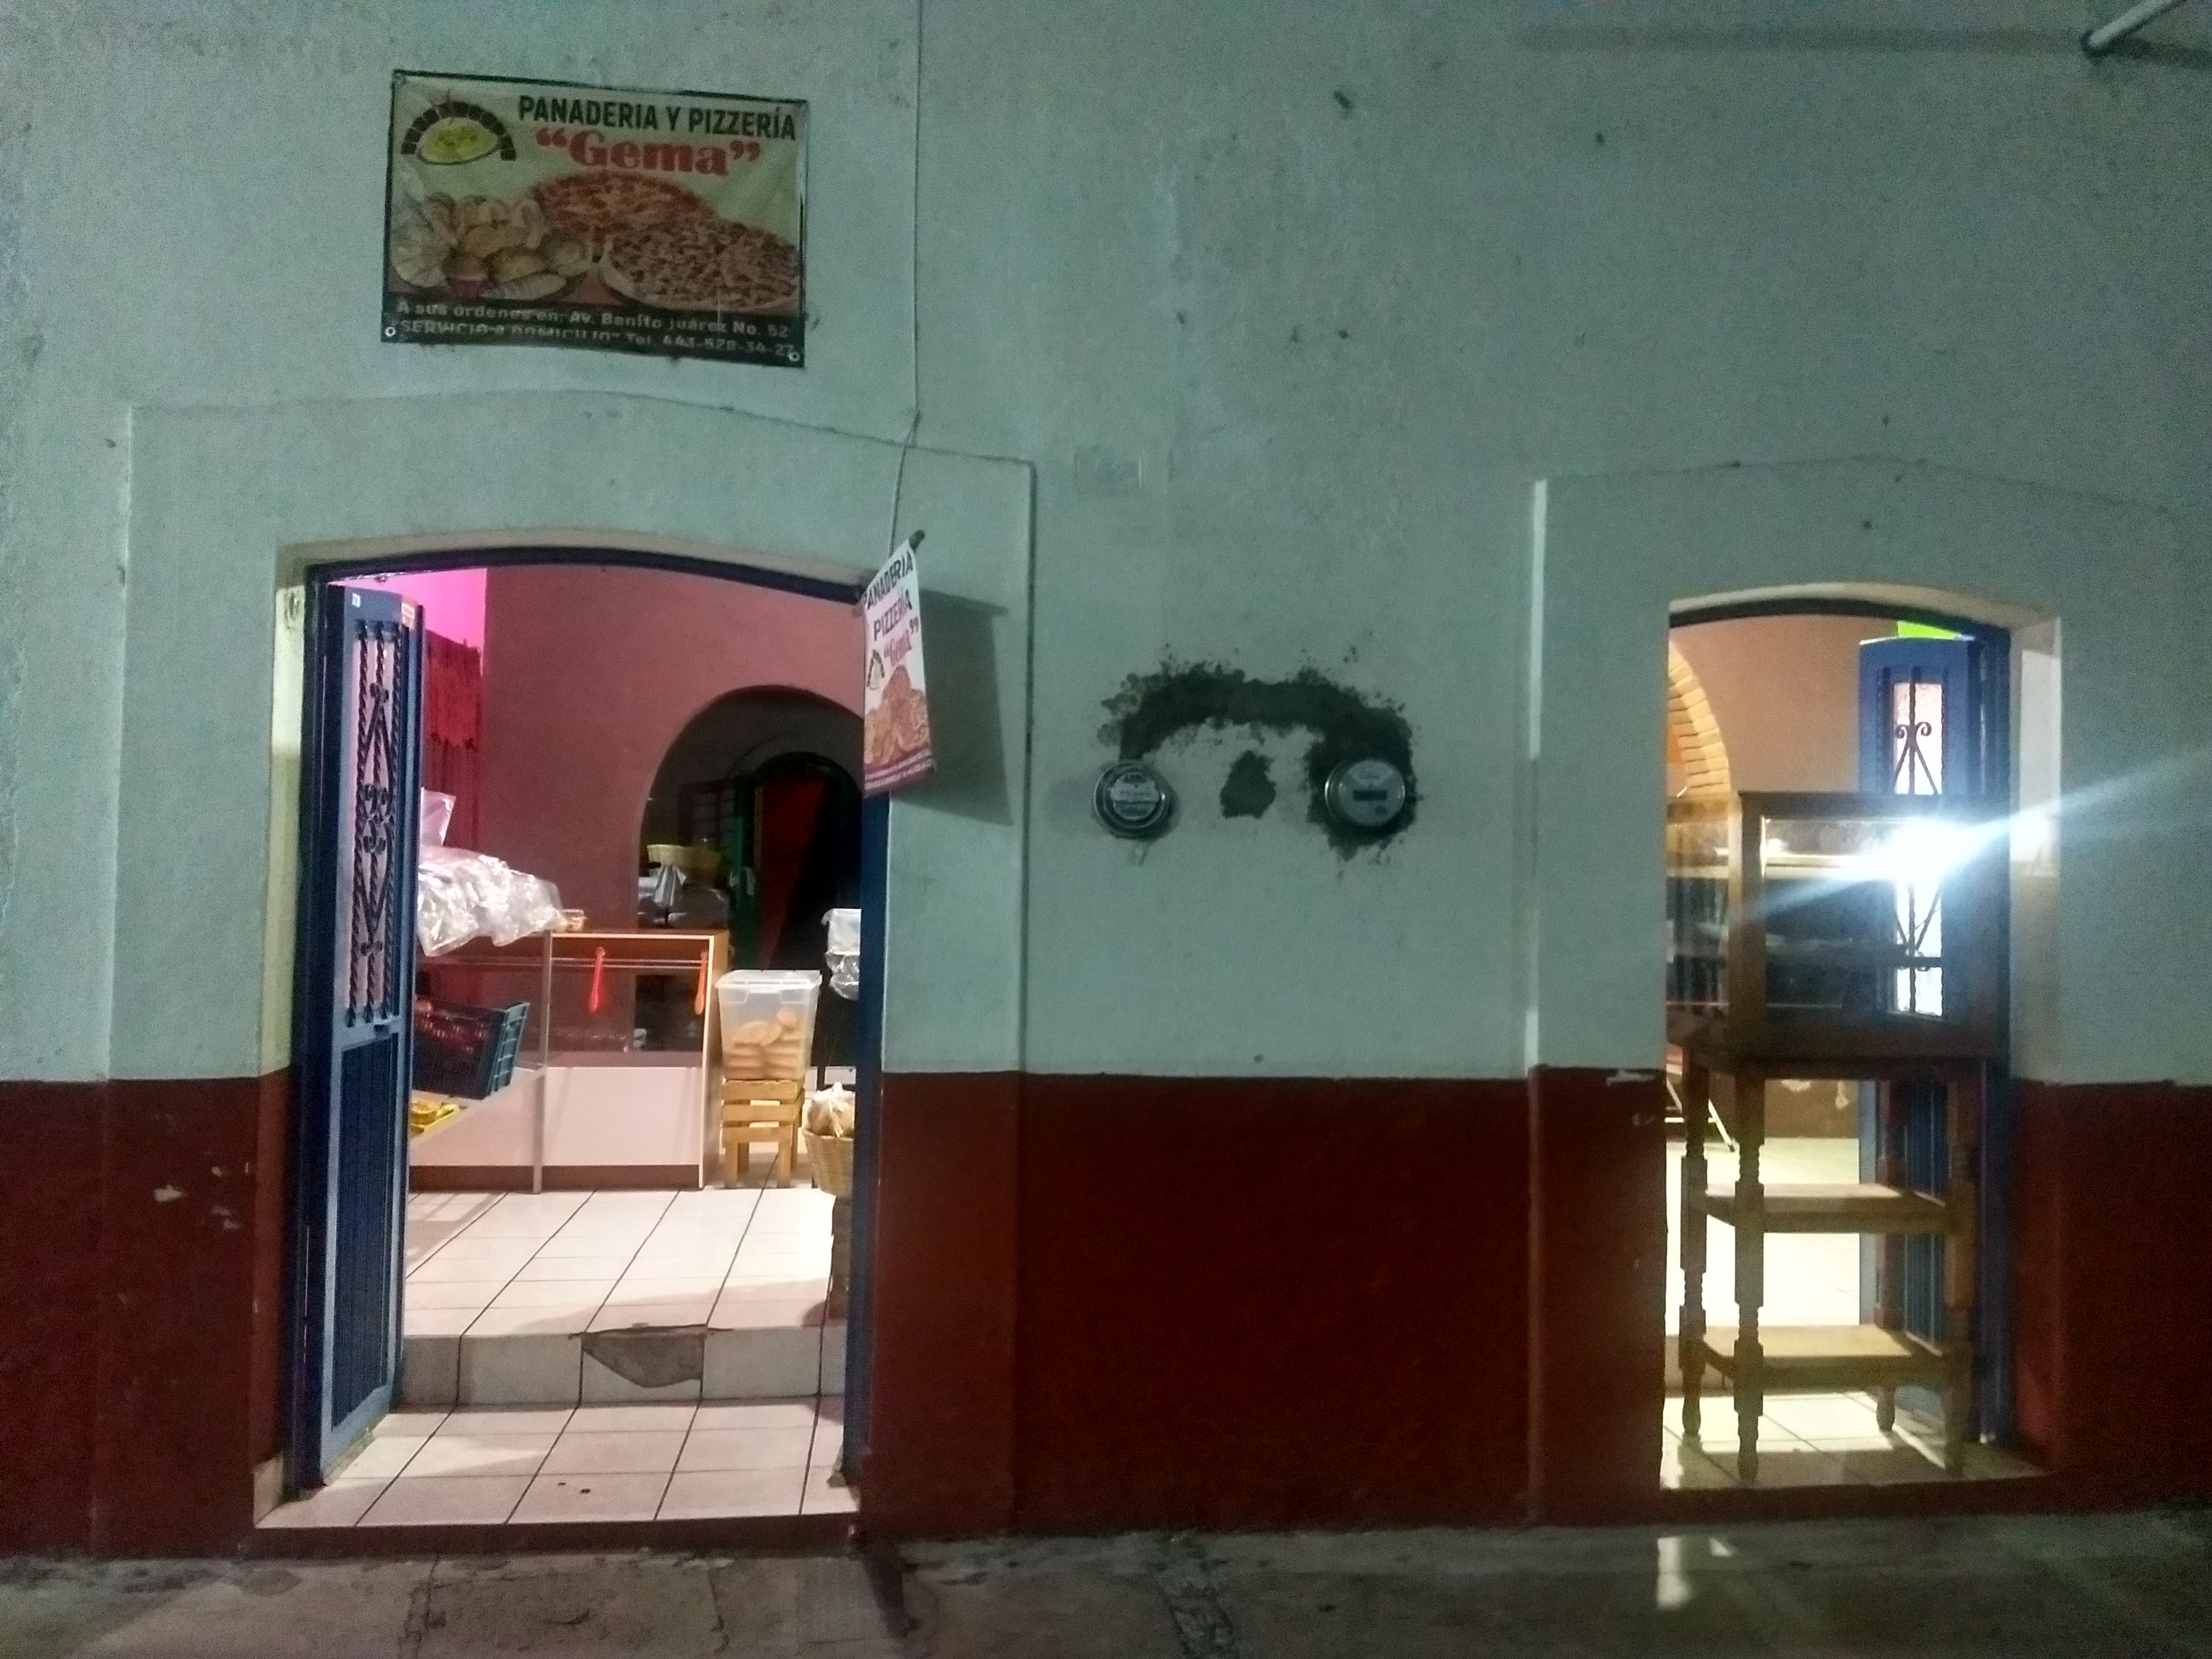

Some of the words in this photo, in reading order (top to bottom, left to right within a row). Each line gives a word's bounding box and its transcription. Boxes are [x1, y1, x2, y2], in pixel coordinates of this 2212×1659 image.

[518, 95, 658, 131] PANADERIA
[666, 106, 681, 132] Y
[688, 108, 795, 141] PIZZERÍA
[602, 312, 662, 329] Benito
